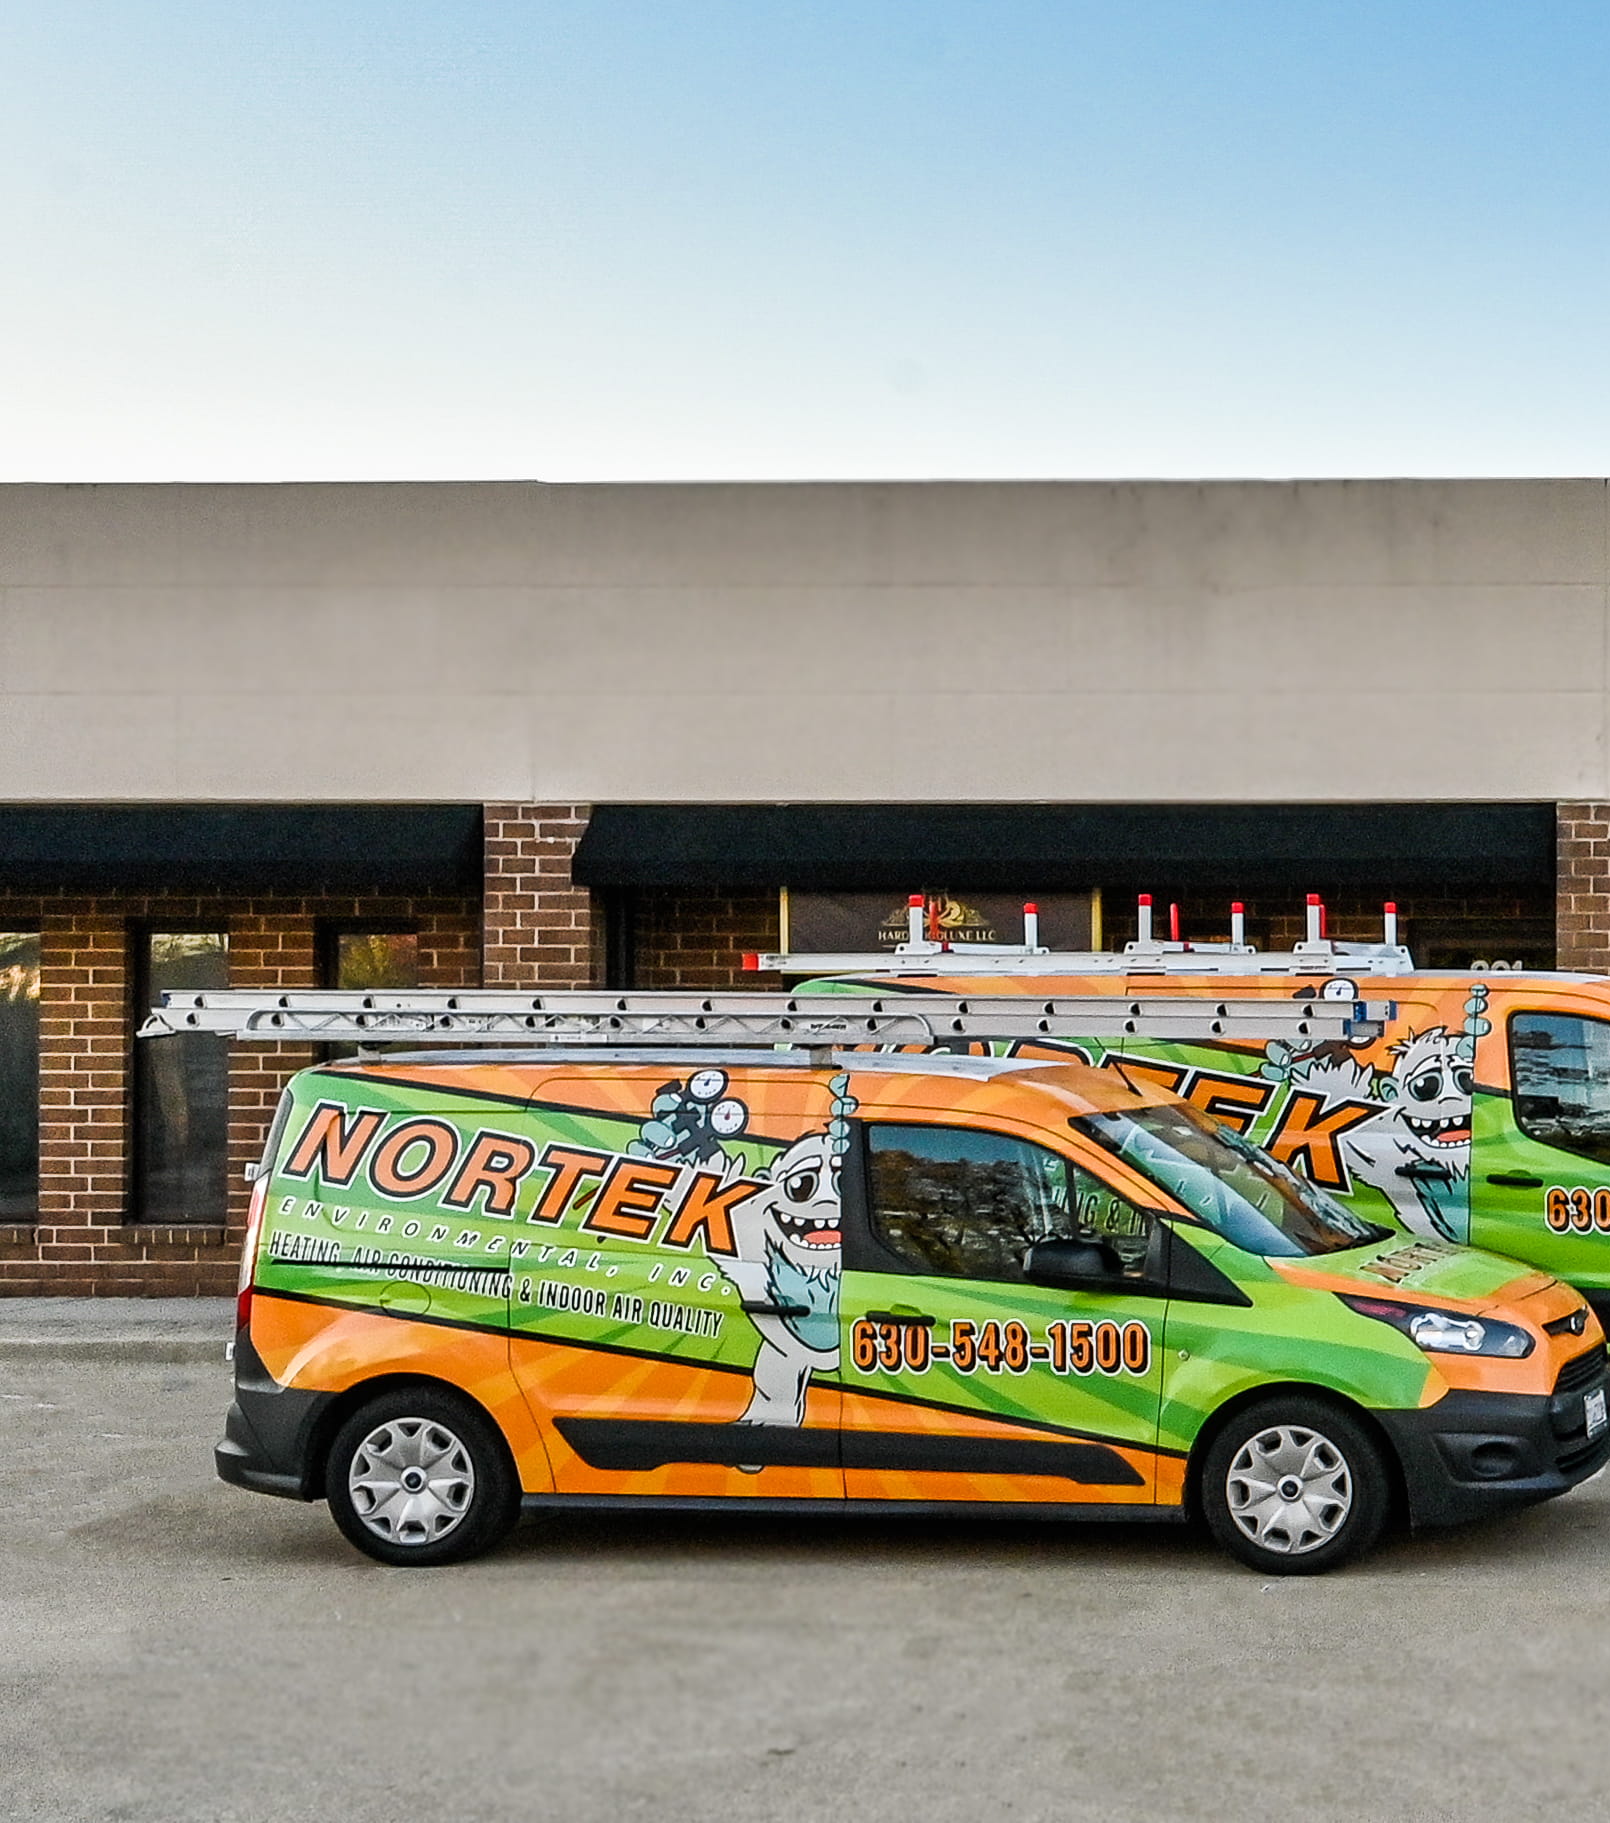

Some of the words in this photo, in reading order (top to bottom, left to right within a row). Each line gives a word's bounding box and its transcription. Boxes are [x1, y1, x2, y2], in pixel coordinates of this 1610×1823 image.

[278, 1098, 774, 1263] NORTEK
[279, 1196, 619, 1277] ENVIRONMENTAL,
[648, 1263, 732, 1296] INC.
[350, 1246, 383, 1276] AIR
[386, 1251, 514, 1299] CONDITIONING
[519, 1278, 532, 1303] &
[538, 1281, 606, 1316] INDOOR
[612, 1294, 643, 1323] AIR
[649, 1301, 725, 1339] QUALITY
[850, 1318, 1151, 1377] 630-548-1500
